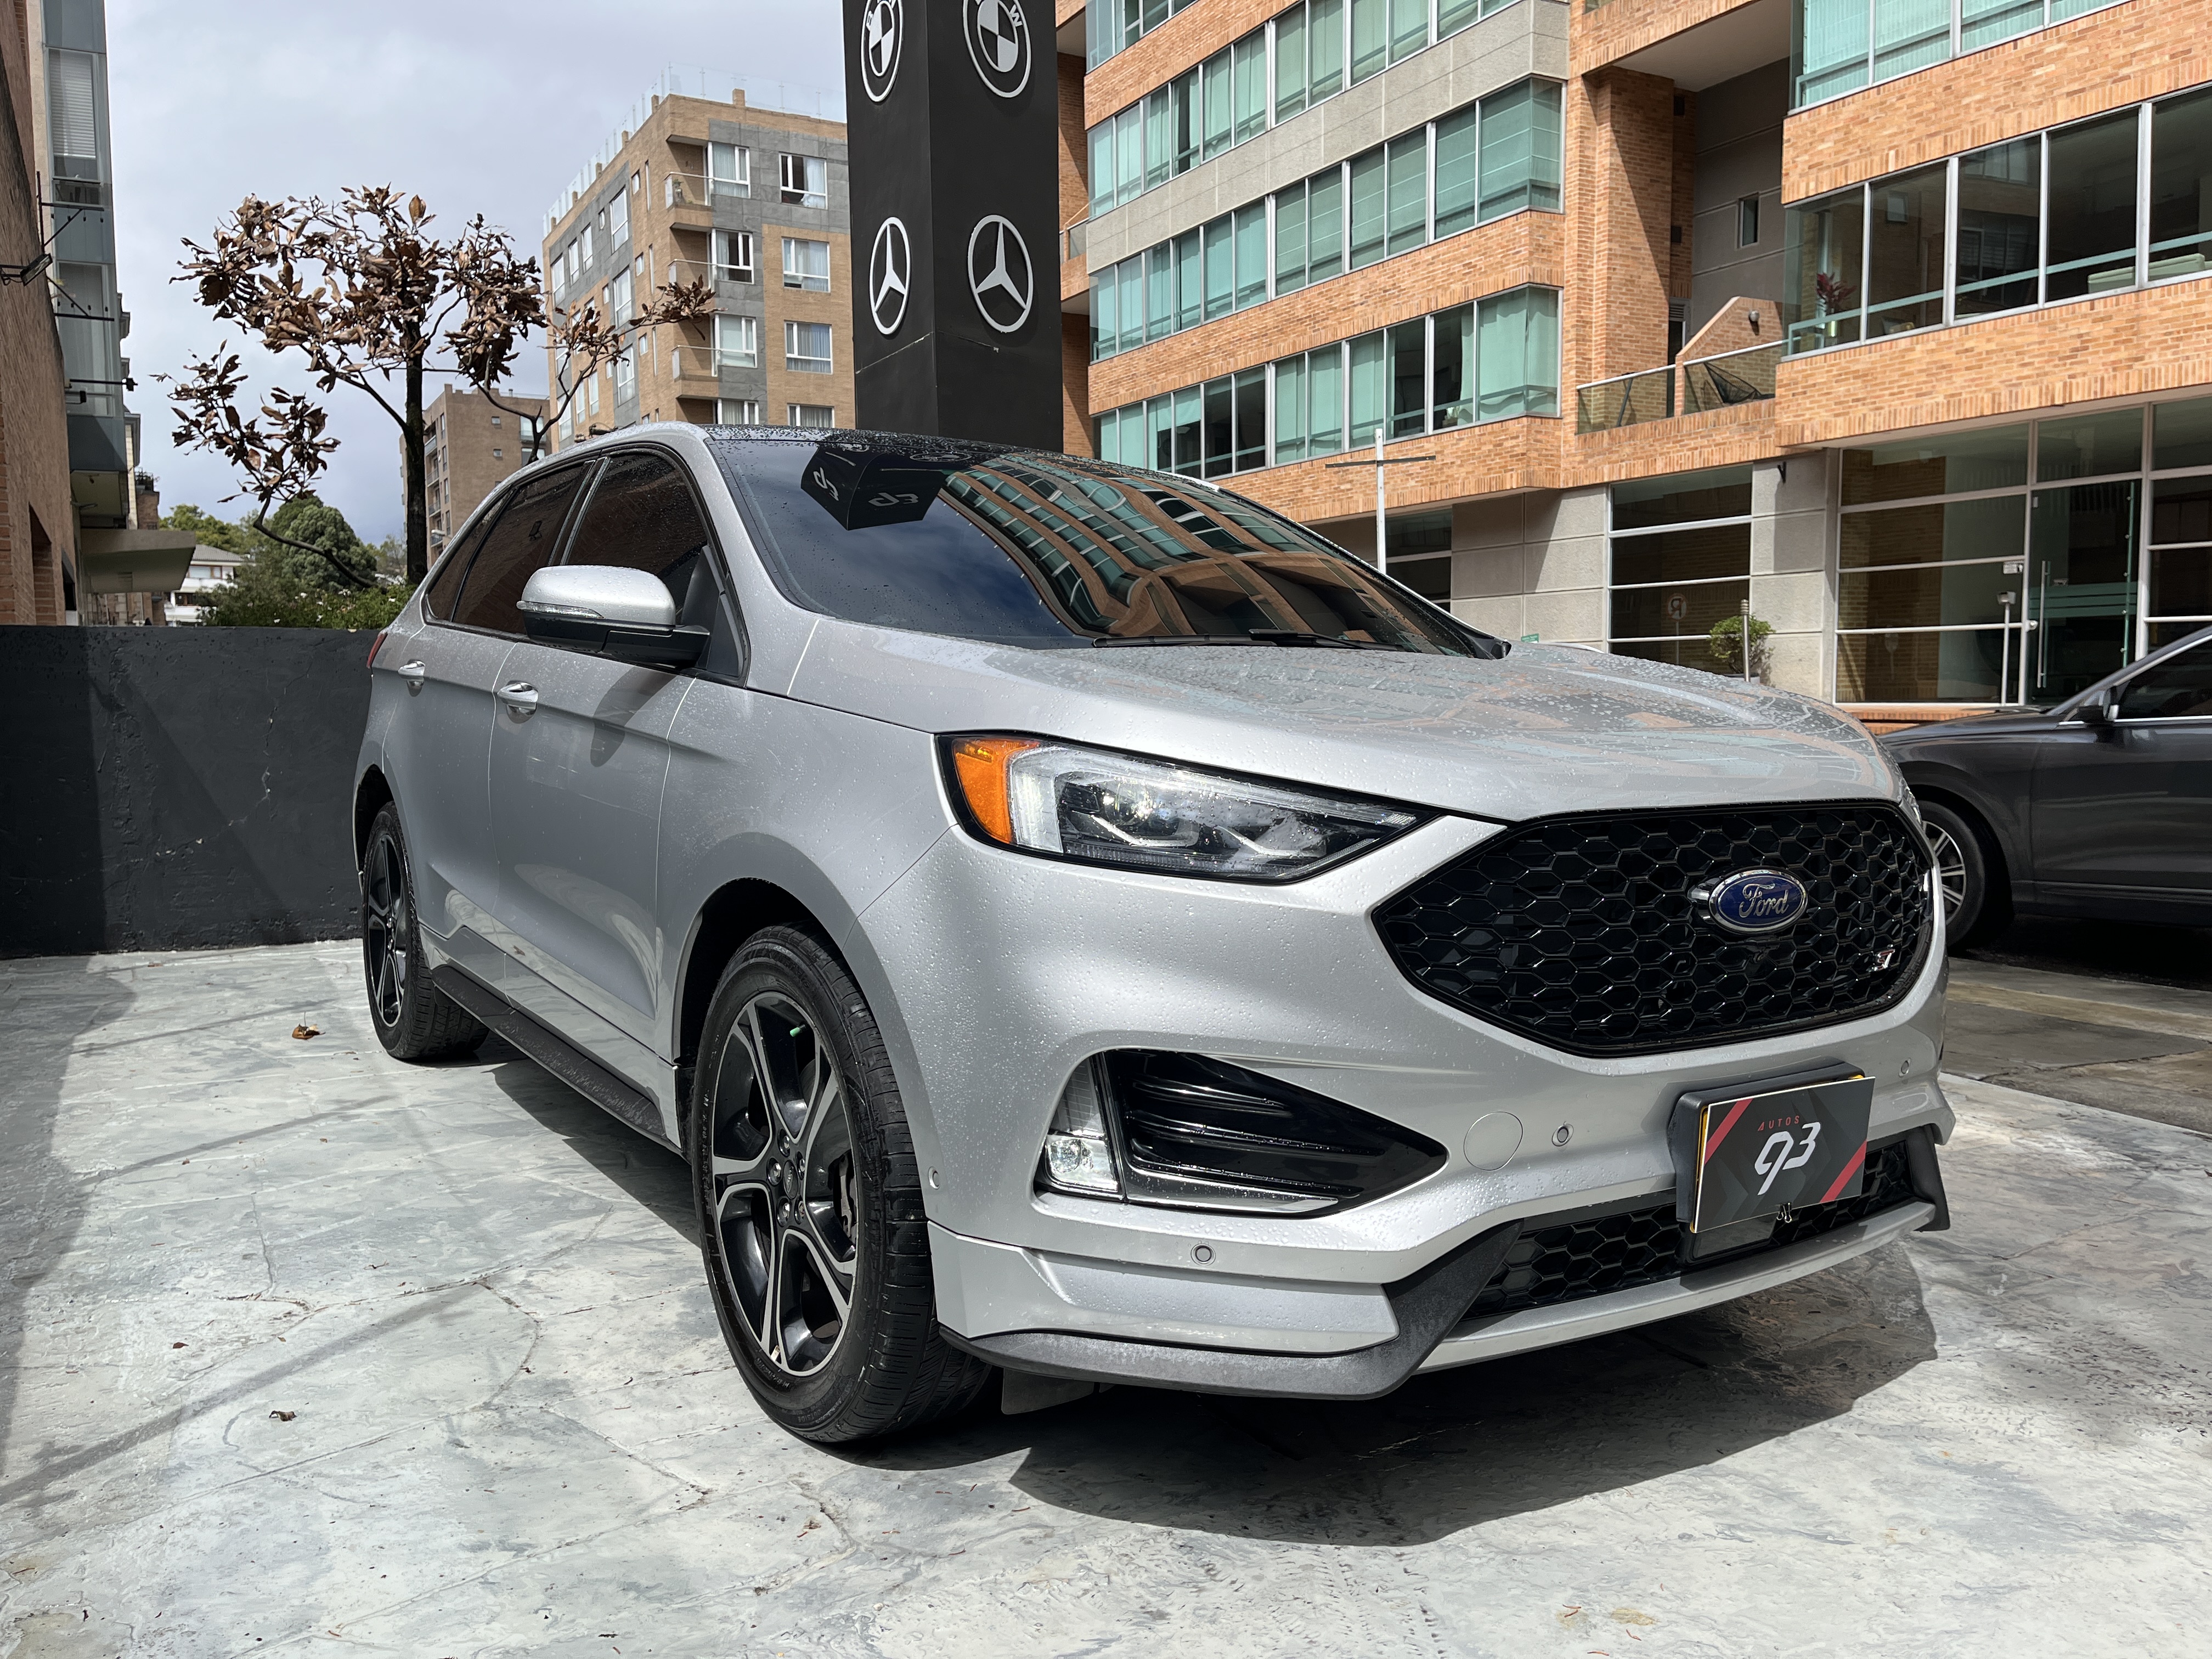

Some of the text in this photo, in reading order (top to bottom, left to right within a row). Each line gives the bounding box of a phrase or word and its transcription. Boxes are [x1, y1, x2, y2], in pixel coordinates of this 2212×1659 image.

[1739, 883, 1790, 918] Ford
[1757, 1115, 1800, 1131] AUTOS
[1754, 1121, 1821, 1196] 93
[797, 1409, 821, 1423] OUTSIDE
